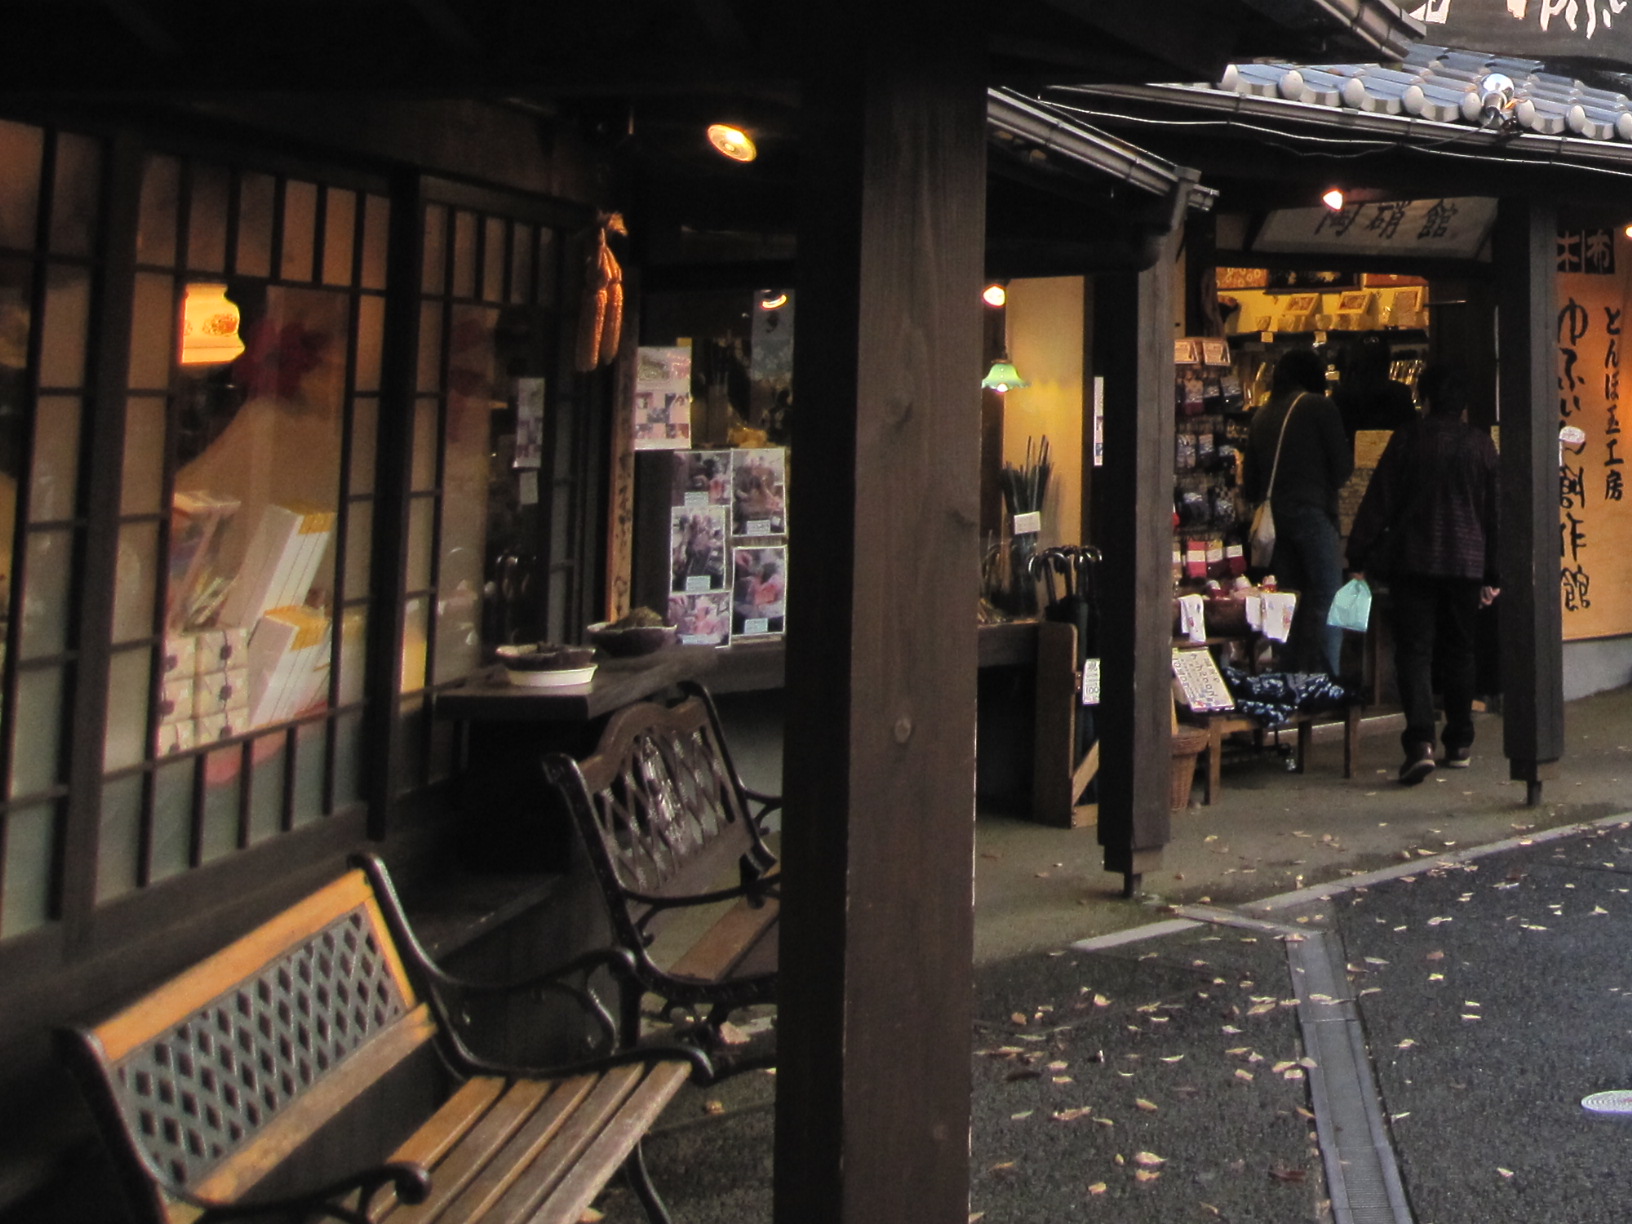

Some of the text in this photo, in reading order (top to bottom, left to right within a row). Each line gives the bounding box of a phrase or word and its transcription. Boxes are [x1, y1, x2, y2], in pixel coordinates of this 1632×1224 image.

[1603, 306, 1625, 501] とんぼ玉工房
